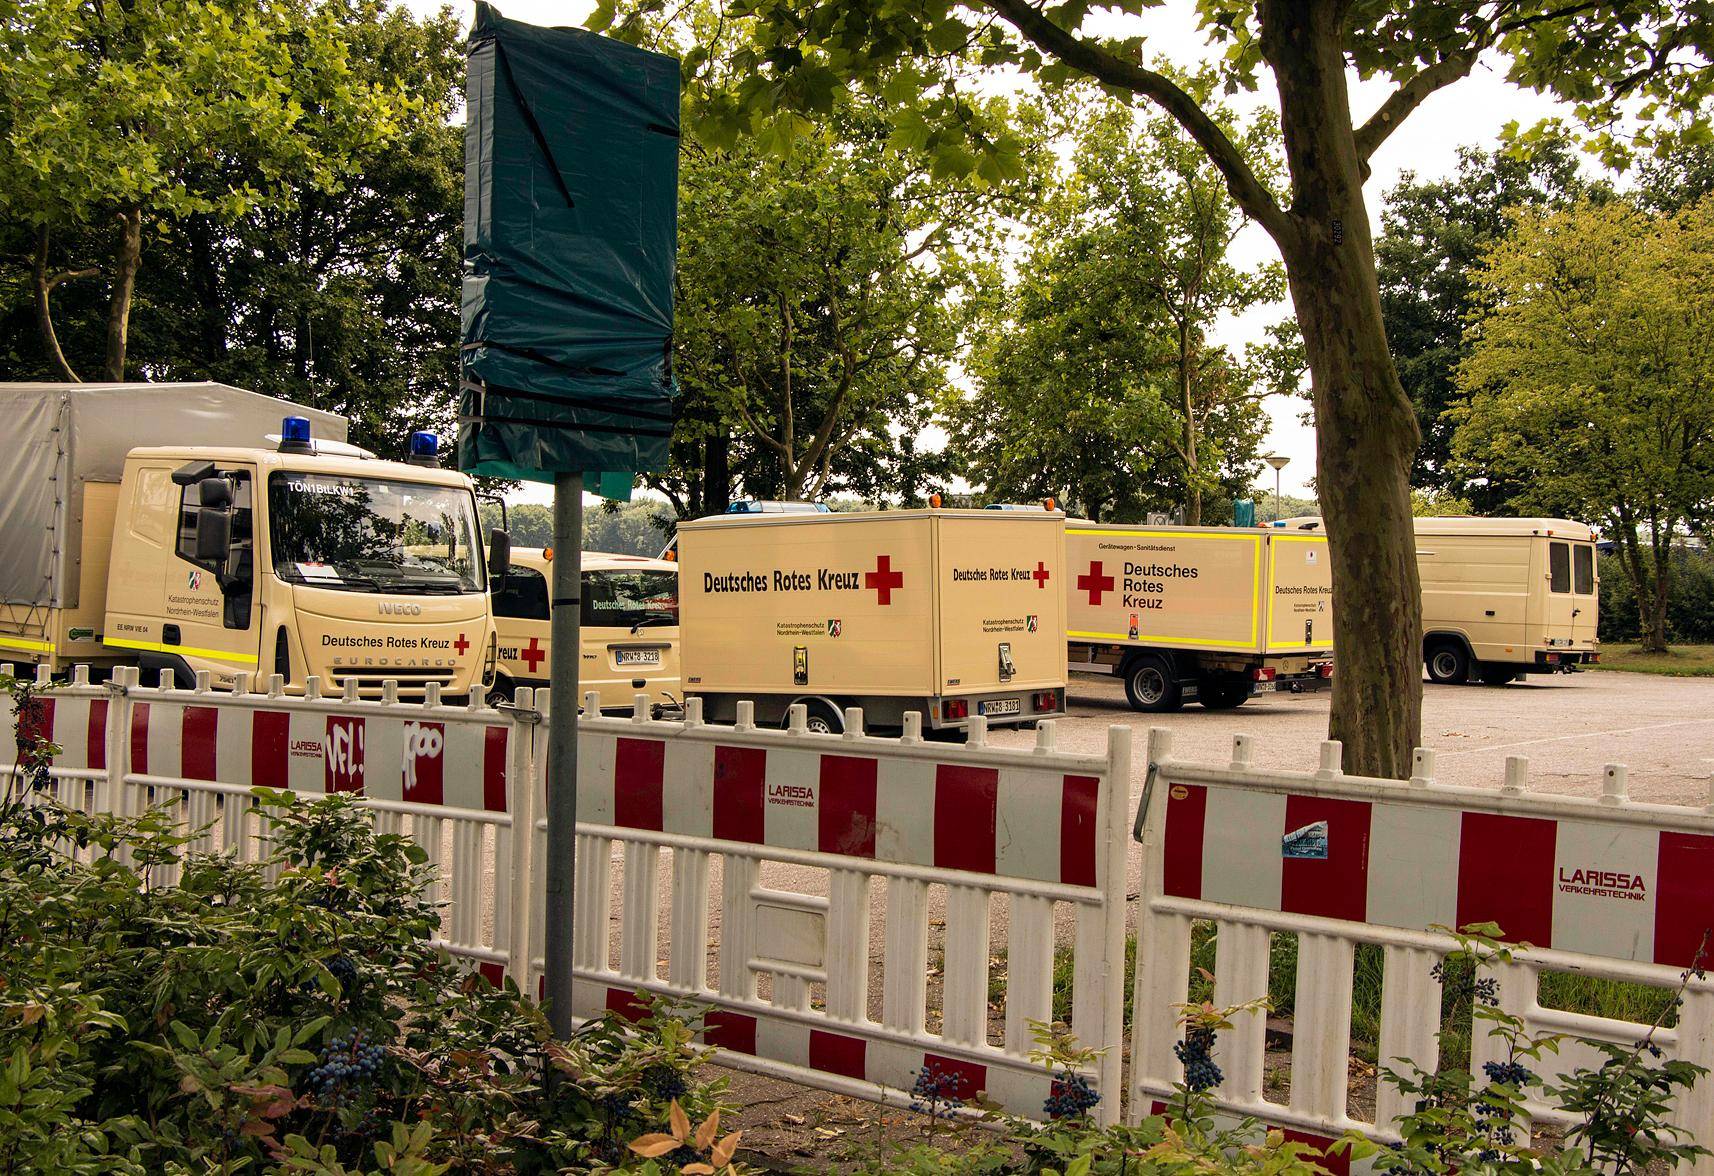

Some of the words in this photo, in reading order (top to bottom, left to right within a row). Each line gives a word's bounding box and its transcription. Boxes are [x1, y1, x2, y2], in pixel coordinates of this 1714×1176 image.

[953, 569, 987, 581] Deutsches
[990, 568, 1008, 580] Rotes
[1011, 568, 1030, 580] Kreuz
[1124, 562, 1198, 579] Deutsches
[704, 571, 767, 593] Deutsches
[774, 570, 811, 592] Rotes
[818, 569, 859, 590] Kreuz
[1123, 578, 1164, 593] Rotes
[1275, 586, 1302, 594] Deutsches
[1304, 586, 1318, 594] Rotes
[168, 594, 219, 606] Katastrophenschutz
[593, 600, 625, 610] Deutsches
[627, 600, 646, 610] Rotes
[1122, 594, 1163, 609] Kreuz
[167, 606, 219, 618] Nordrhein-Westfalen
[378, 601, 421, 615] IVECO
[777, 622, 825, 630] Katastrophenschutz
[322, 635, 383, 648] Deutsches
[386, 636, 417, 648] Rotes
[420, 638, 450, 649] Kreuz
[497, 646, 518, 660] reuz
[333, 657, 456, 666] EUROCARGO
[984, 703, 996, 712] NRW
[291, 740, 322, 752] LARISSA
[768, 784, 813, 799] LARISSA
[768, 798, 814, 807] VERKEHRSTECHNIK
[1559, 867, 1646, 891] LARISSA
[1558, 884, 1645, 901] VERKEHRSTECHNIK
